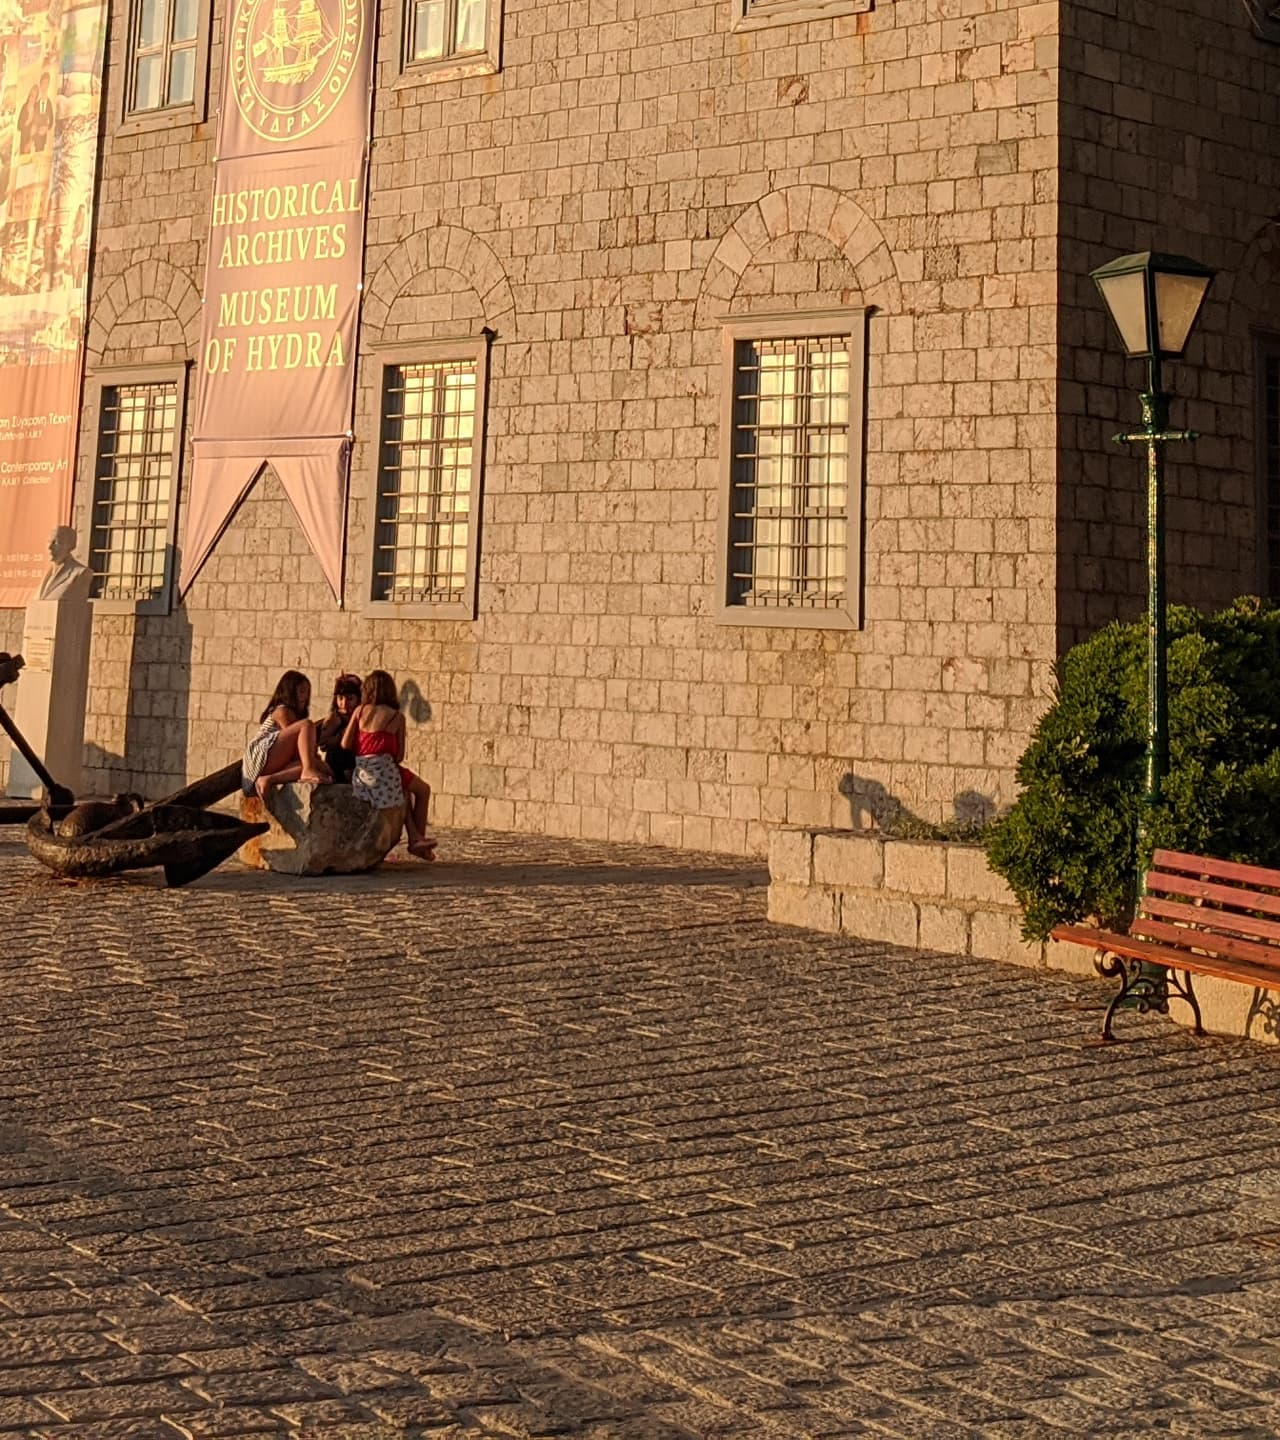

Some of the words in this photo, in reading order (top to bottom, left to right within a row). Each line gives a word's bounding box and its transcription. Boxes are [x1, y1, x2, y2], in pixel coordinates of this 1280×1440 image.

[258, 96, 326, 134] ΥΔΡΑΣ
[212, 179, 361, 227] HISTORICAL
[217, 223, 346, 269] ARCHIVES
[216, 283, 339, 328] MUSEUM
[204, 337, 236, 375] OF
[245, 330, 345, 372] HYDRA
[0, 461, 55, 475] Contemporary
